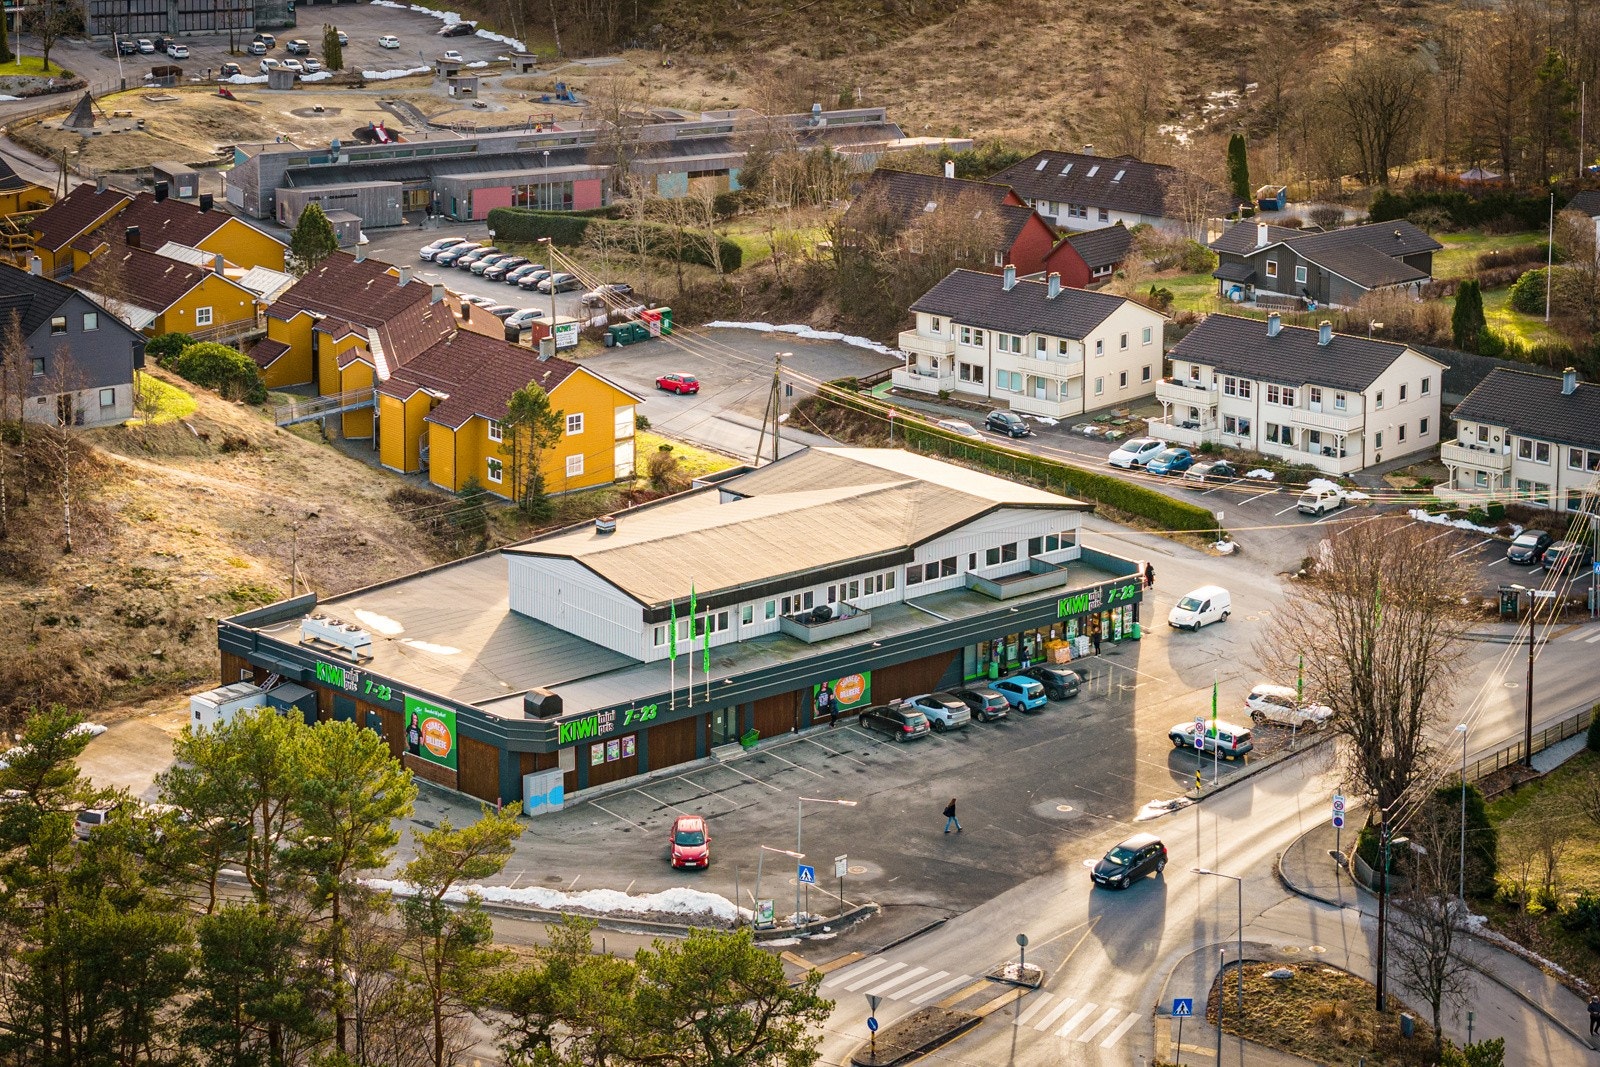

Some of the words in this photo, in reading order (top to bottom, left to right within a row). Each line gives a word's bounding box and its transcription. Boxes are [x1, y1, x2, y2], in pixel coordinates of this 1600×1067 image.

[1057, 593, 1089, 618] KIWI
[316, 660, 346, 689] KIWI
[558, 715, 598, 744] KIWI
[597, 721, 614, 736] pris
